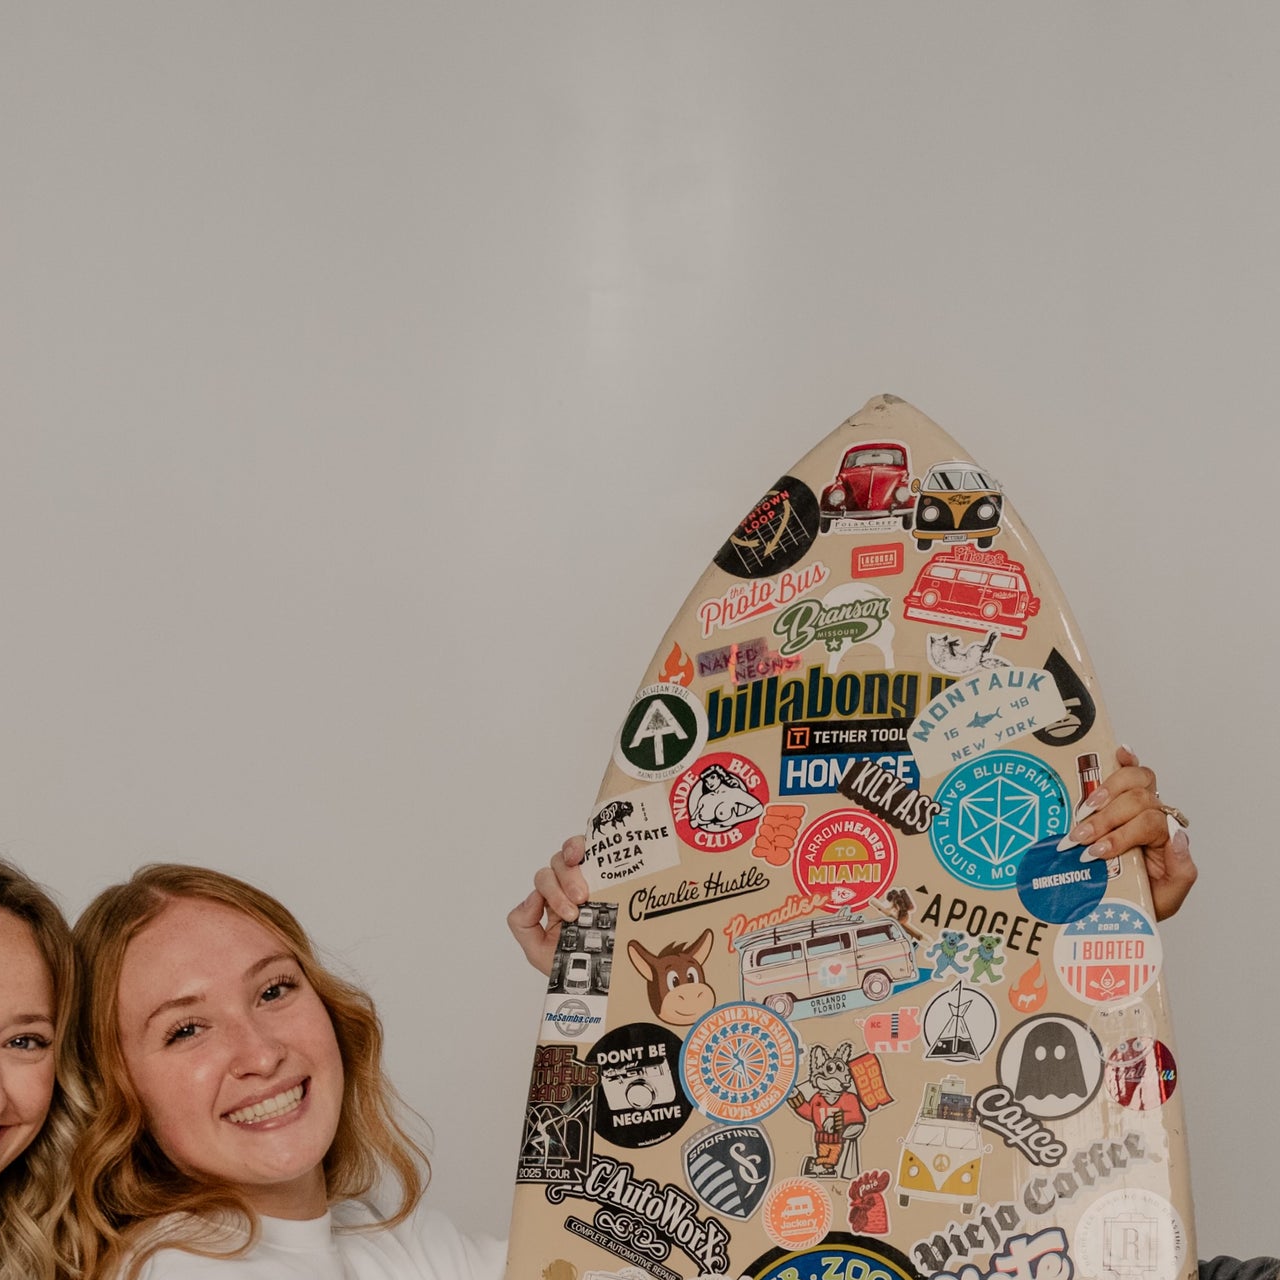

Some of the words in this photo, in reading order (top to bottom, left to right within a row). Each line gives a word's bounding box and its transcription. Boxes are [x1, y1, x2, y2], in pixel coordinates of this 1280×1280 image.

[744, 510, 776, 534] LOOP
[700, 580, 776, 636] Photo
[775, 564, 827, 605] Bus
[776, 598, 888, 654] Branson
[816, 627, 860, 638] MISSOURI
[705, 664, 921, 744] billabong
[912, 670, 1046, 742] MONTAUK
[943, 727, 960, 741] 16
[1009, 696, 1030, 711] 48
[813, 729, 868, 744] TETHER
[951, 738, 987, 762] NEW
[994, 716, 1038, 741] YORK
[727, 757, 762, 789] BUS
[973, 762, 1057, 799] BLUEPRINT
[672, 769, 700, 824] NUDE
[850, 760, 907, 811] KICK
[892, 789, 941, 833] ASS
[937, 780, 967, 828] SAINT
[625, 826, 669, 842] STATE
[693, 826, 743, 848] CLUB
[597, 844, 643, 868] PIZZA
[834, 846, 857, 857] TO
[600, 859, 645, 880] COMPANY
[808, 862, 882, 885] MIAMI
[1031, 867, 1092, 890] BIRKENSTOCK
[628, 880, 700, 922] Charlie
[703, 865, 770, 898] Hustle
[920, 893, 1049, 957] APOGEE
[1082, 939, 1145, 961] BOATED
[810, 993, 848, 1008] ORLANDO
[812, 1001, 847, 1015] FLORIDA
[596, 1046, 644, 1066] DON'T
[648, 1043, 667, 1058] BE
[612, 1104, 682, 1128] NEGATIVE
[688, 1127, 760, 1161] SPORTING
[545, 1167, 571, 1180] TOUR
[570, 1221, 608, 1246] COMPLETE
[605, 1238, 653, 1272] AUTOMOTIVE
